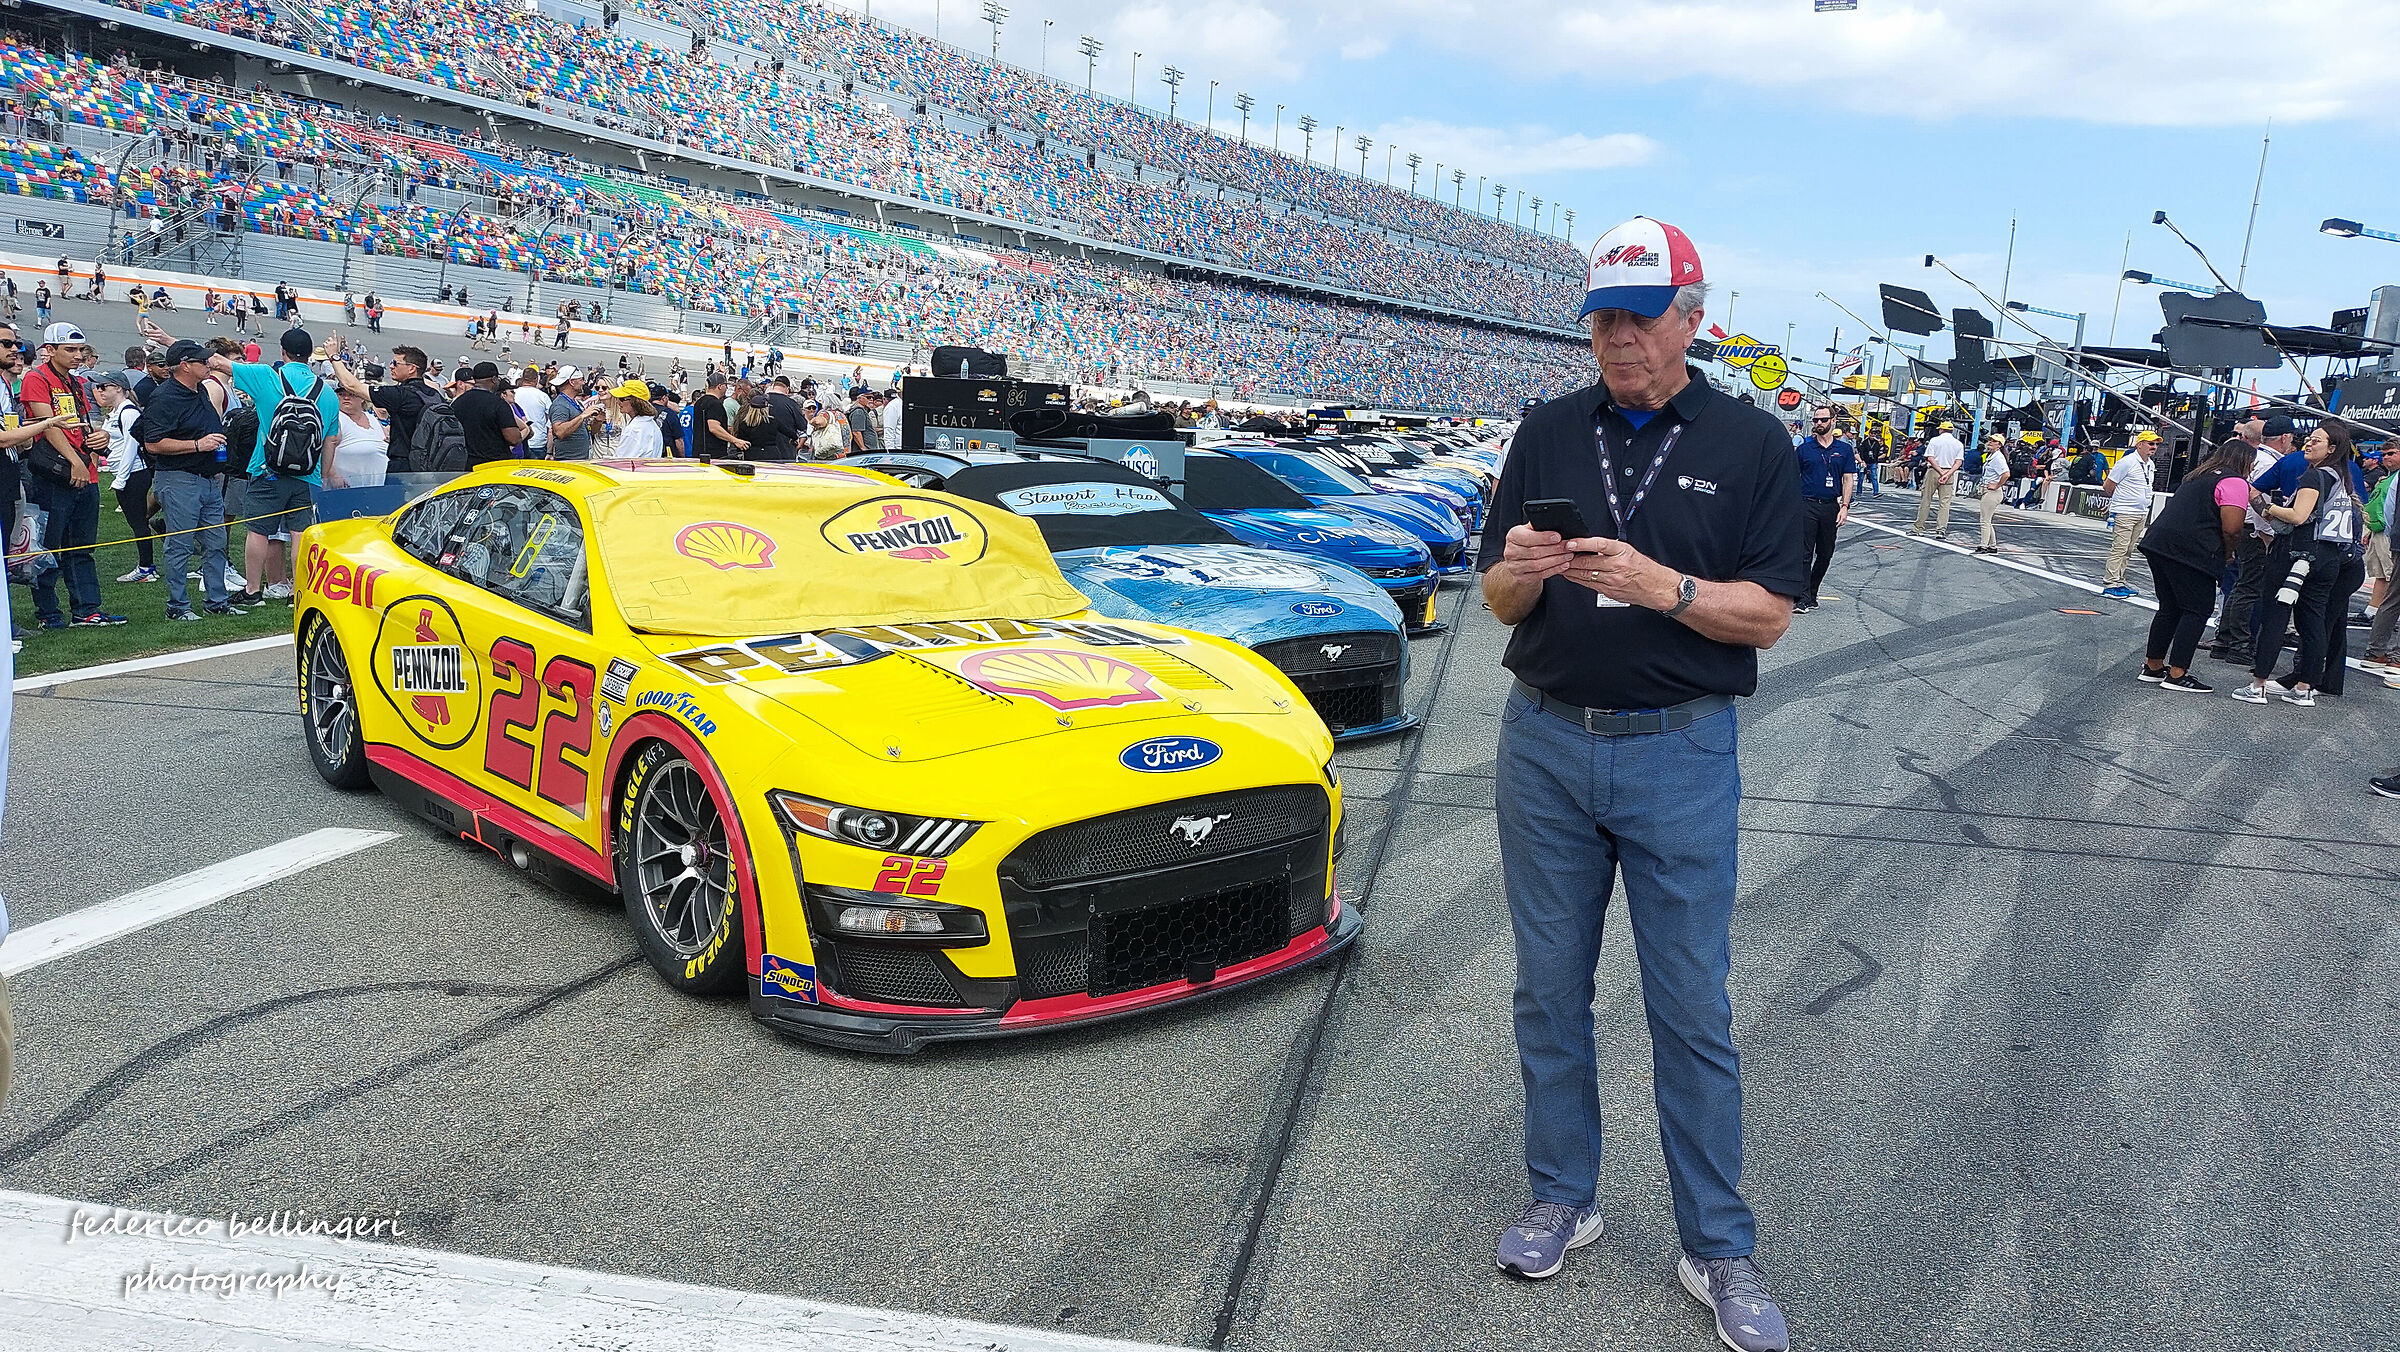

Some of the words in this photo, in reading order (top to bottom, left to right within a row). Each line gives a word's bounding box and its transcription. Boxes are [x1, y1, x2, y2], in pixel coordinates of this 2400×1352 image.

[1006, 388, 1028, 407] 84
[1779, 391, 1801, 406] 50
[924, 413, 977, 428] LEGACY
[1013, 489, 1096, 507] Stewart
[1694, 479, 1718, 491] DN
[846, 515, 963, 553] PENNZOIL
[2321, 509, 2353, 540] 20
[306, 543, 389, 610] Shell
[1302, 602, 1337, 616] Ford
[393, 645, 467, 693] PENNZOIL
[484, 635, 597, 822] 22
[1142, 740, 1205, 768] Ford
[620, 753, 651, 834] EAGLE
[872, 855, 948, 896] 22
[766, 970, 812, 992] SUNOCO
